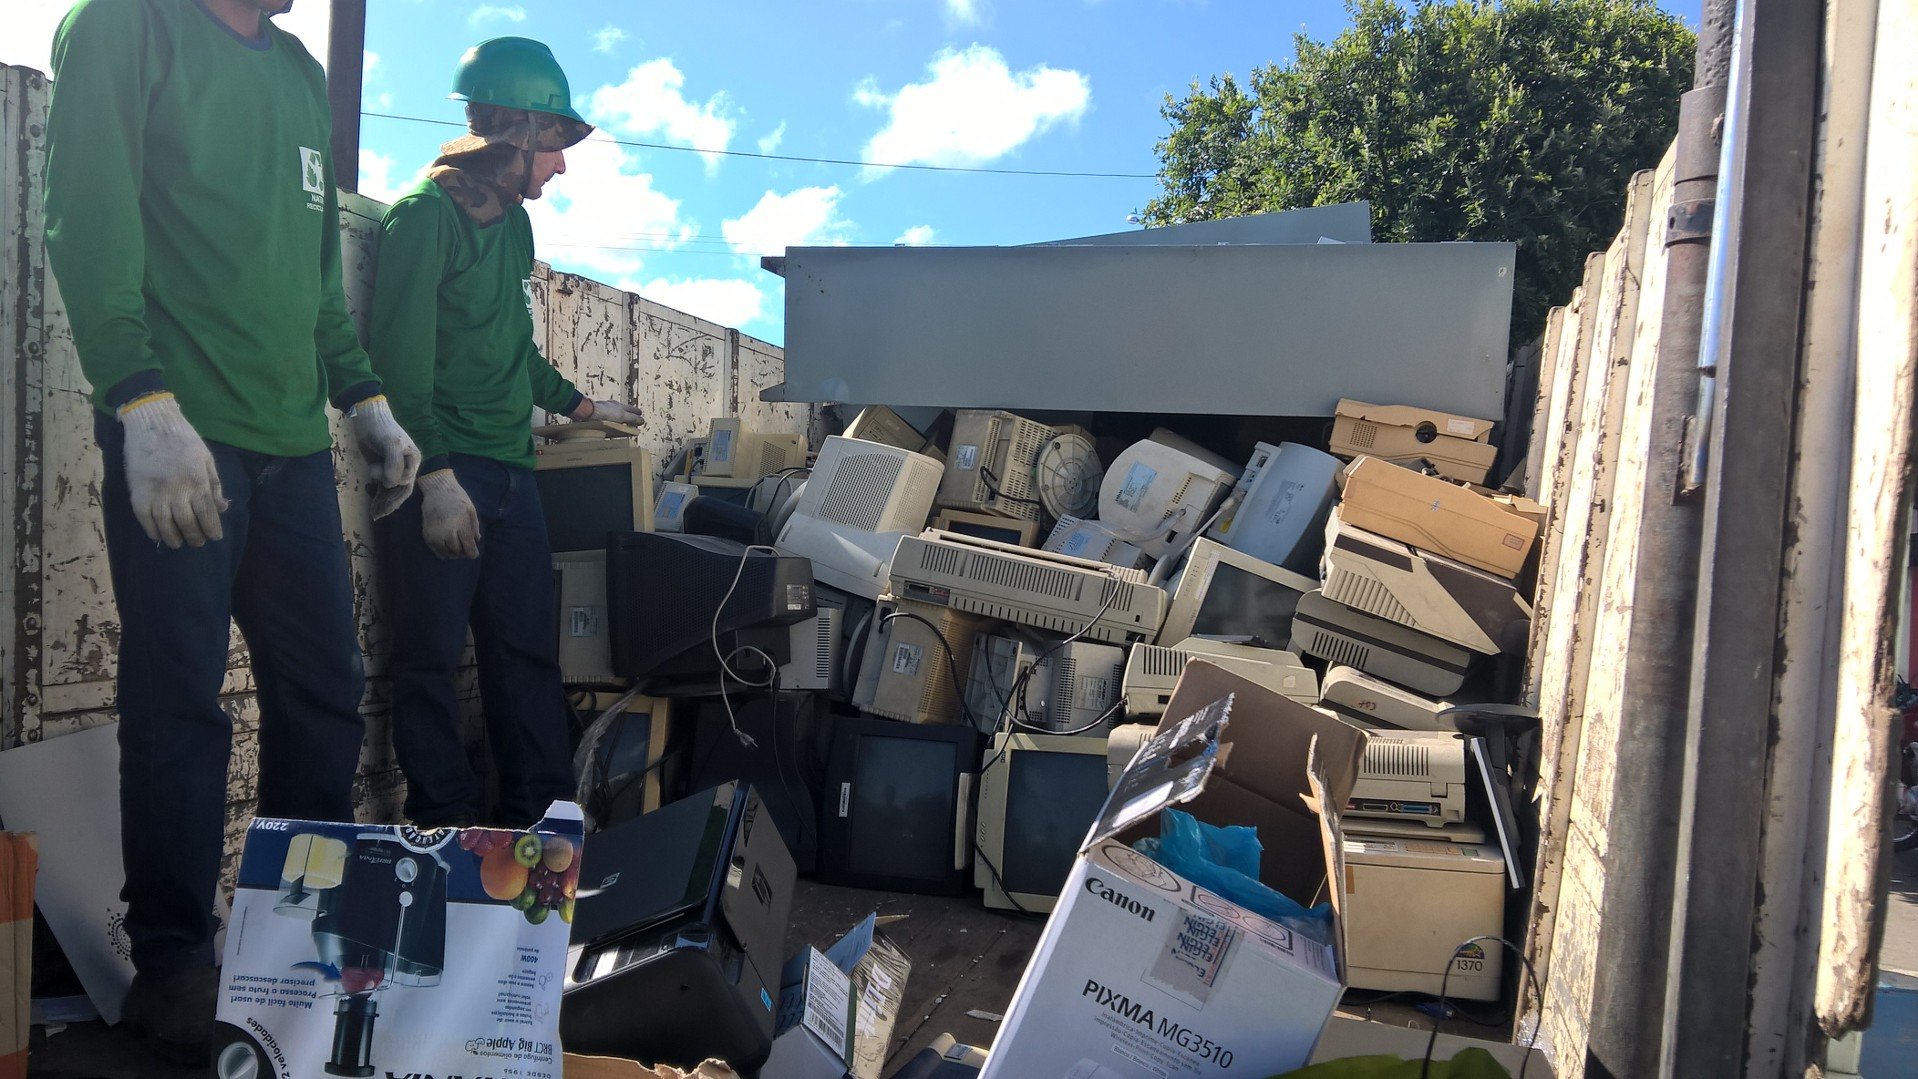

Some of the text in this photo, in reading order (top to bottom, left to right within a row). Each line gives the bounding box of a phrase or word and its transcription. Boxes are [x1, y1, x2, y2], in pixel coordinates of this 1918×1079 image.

[256, 820, 290, 831] 220V
[1085, 877, 1155, 922] Canon
[1184, 916, 1216, 937] ELGIN
[1177, 932, 1210, 953] ELGIN
[1187, 926, 1220, 947] ELGIN
[520, 954, 538, 963] 400W
[1180, 942, 1212, 962] ELGIN
[1457, 960, 1483, 971] 1370
[233, 974, 315, 986] precisar descascar!
[249, 987, 269, 995] fruta
[280, 989, 317, 998] Processa
[230, 995, 312, 1009] Muito fácil de usar!
[1082, 979, 1234, 1068] PIXMA MG3510
[246, 1017, 286, 1070] velocidades
[487, 1037, 552, 1055] BRCT Big Apple
